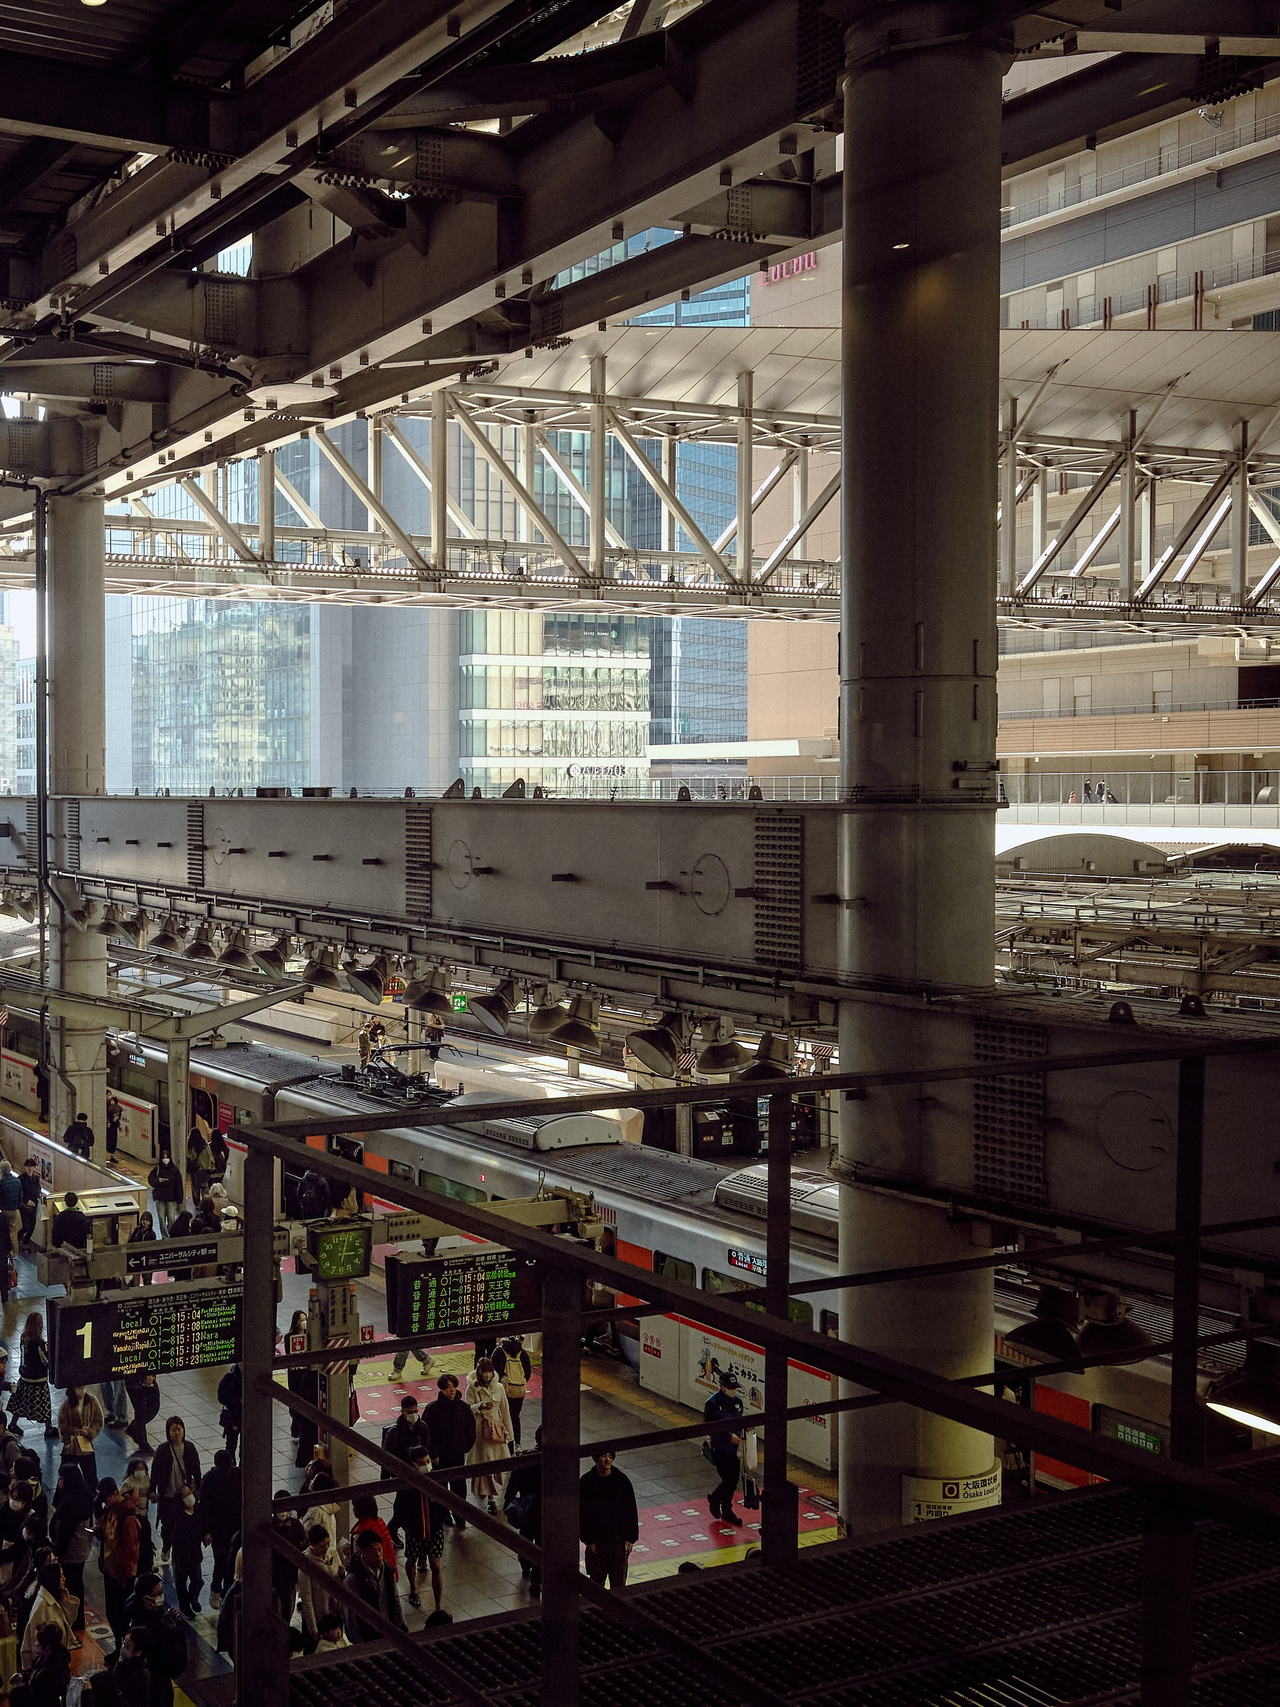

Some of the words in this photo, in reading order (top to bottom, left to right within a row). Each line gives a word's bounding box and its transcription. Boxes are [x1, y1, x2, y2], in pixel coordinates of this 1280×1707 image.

[141, 1256, 146, 1266] 1
[464, 1272, 485, 1283] 15:04
[464, 1282, 485, 1294] 15:09
[488, 1280, 511, 1291] 天王寺
[463, 1292, 484, 1304] 15:14
[488, 1290, 510, 1302] 天王寺
[463, 1303, 484, 1315] 15:19
[121, 1317, 142, 1329] Local
[177, 1310, 200, 1322] 15:04
[462, 1314, 483, 1326] 15:24
[486, 1310, 510, 1322] 天王寺
[177, 1321, 200, 1333] 15:08
[75, 1321, 93, 1360] 1
[176, 1332, 200, 1344] 15:13
[201, 1331, 219, 1340] Nara
[120, 1352, 141, 1363] Local
[176, 1343, 200, 1356] 15:19
[176, 1354, 199, 1367] 15:23
[945, 1484, 958, 1498] O
[915, 1504, 922, 1516] 1
